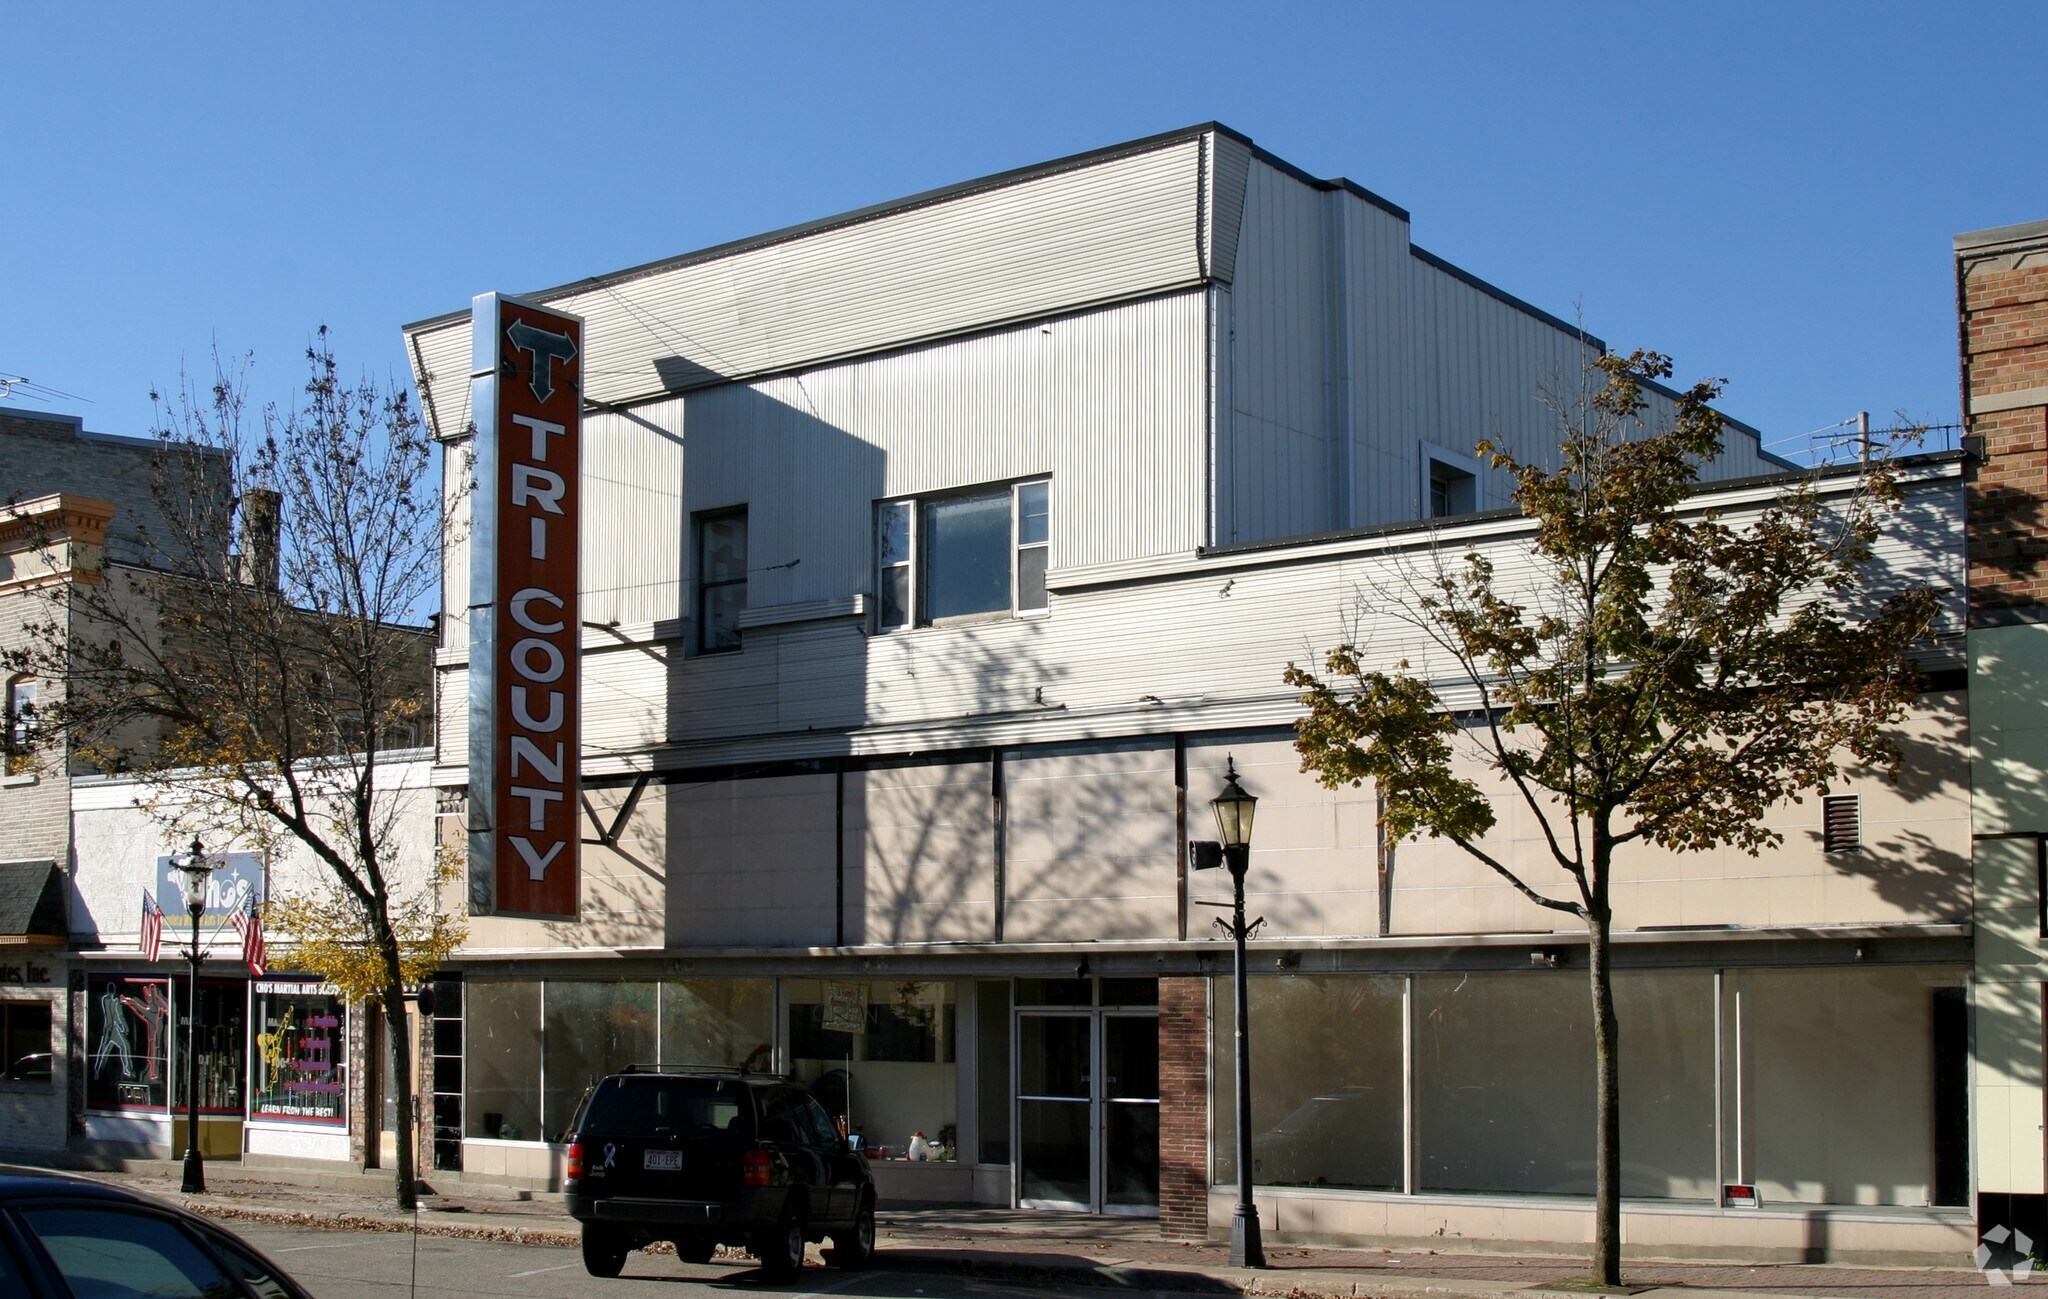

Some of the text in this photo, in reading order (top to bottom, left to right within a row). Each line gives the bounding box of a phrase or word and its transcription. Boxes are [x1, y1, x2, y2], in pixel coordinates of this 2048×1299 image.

[507, 413, 567, 882] TRI COUNTY
[274, 984, 300, 994] MARTIAL
[302, 985, 317, 994] ARTS
[261, 1104, 334, 1117] LEARN FROM THE BEST!
